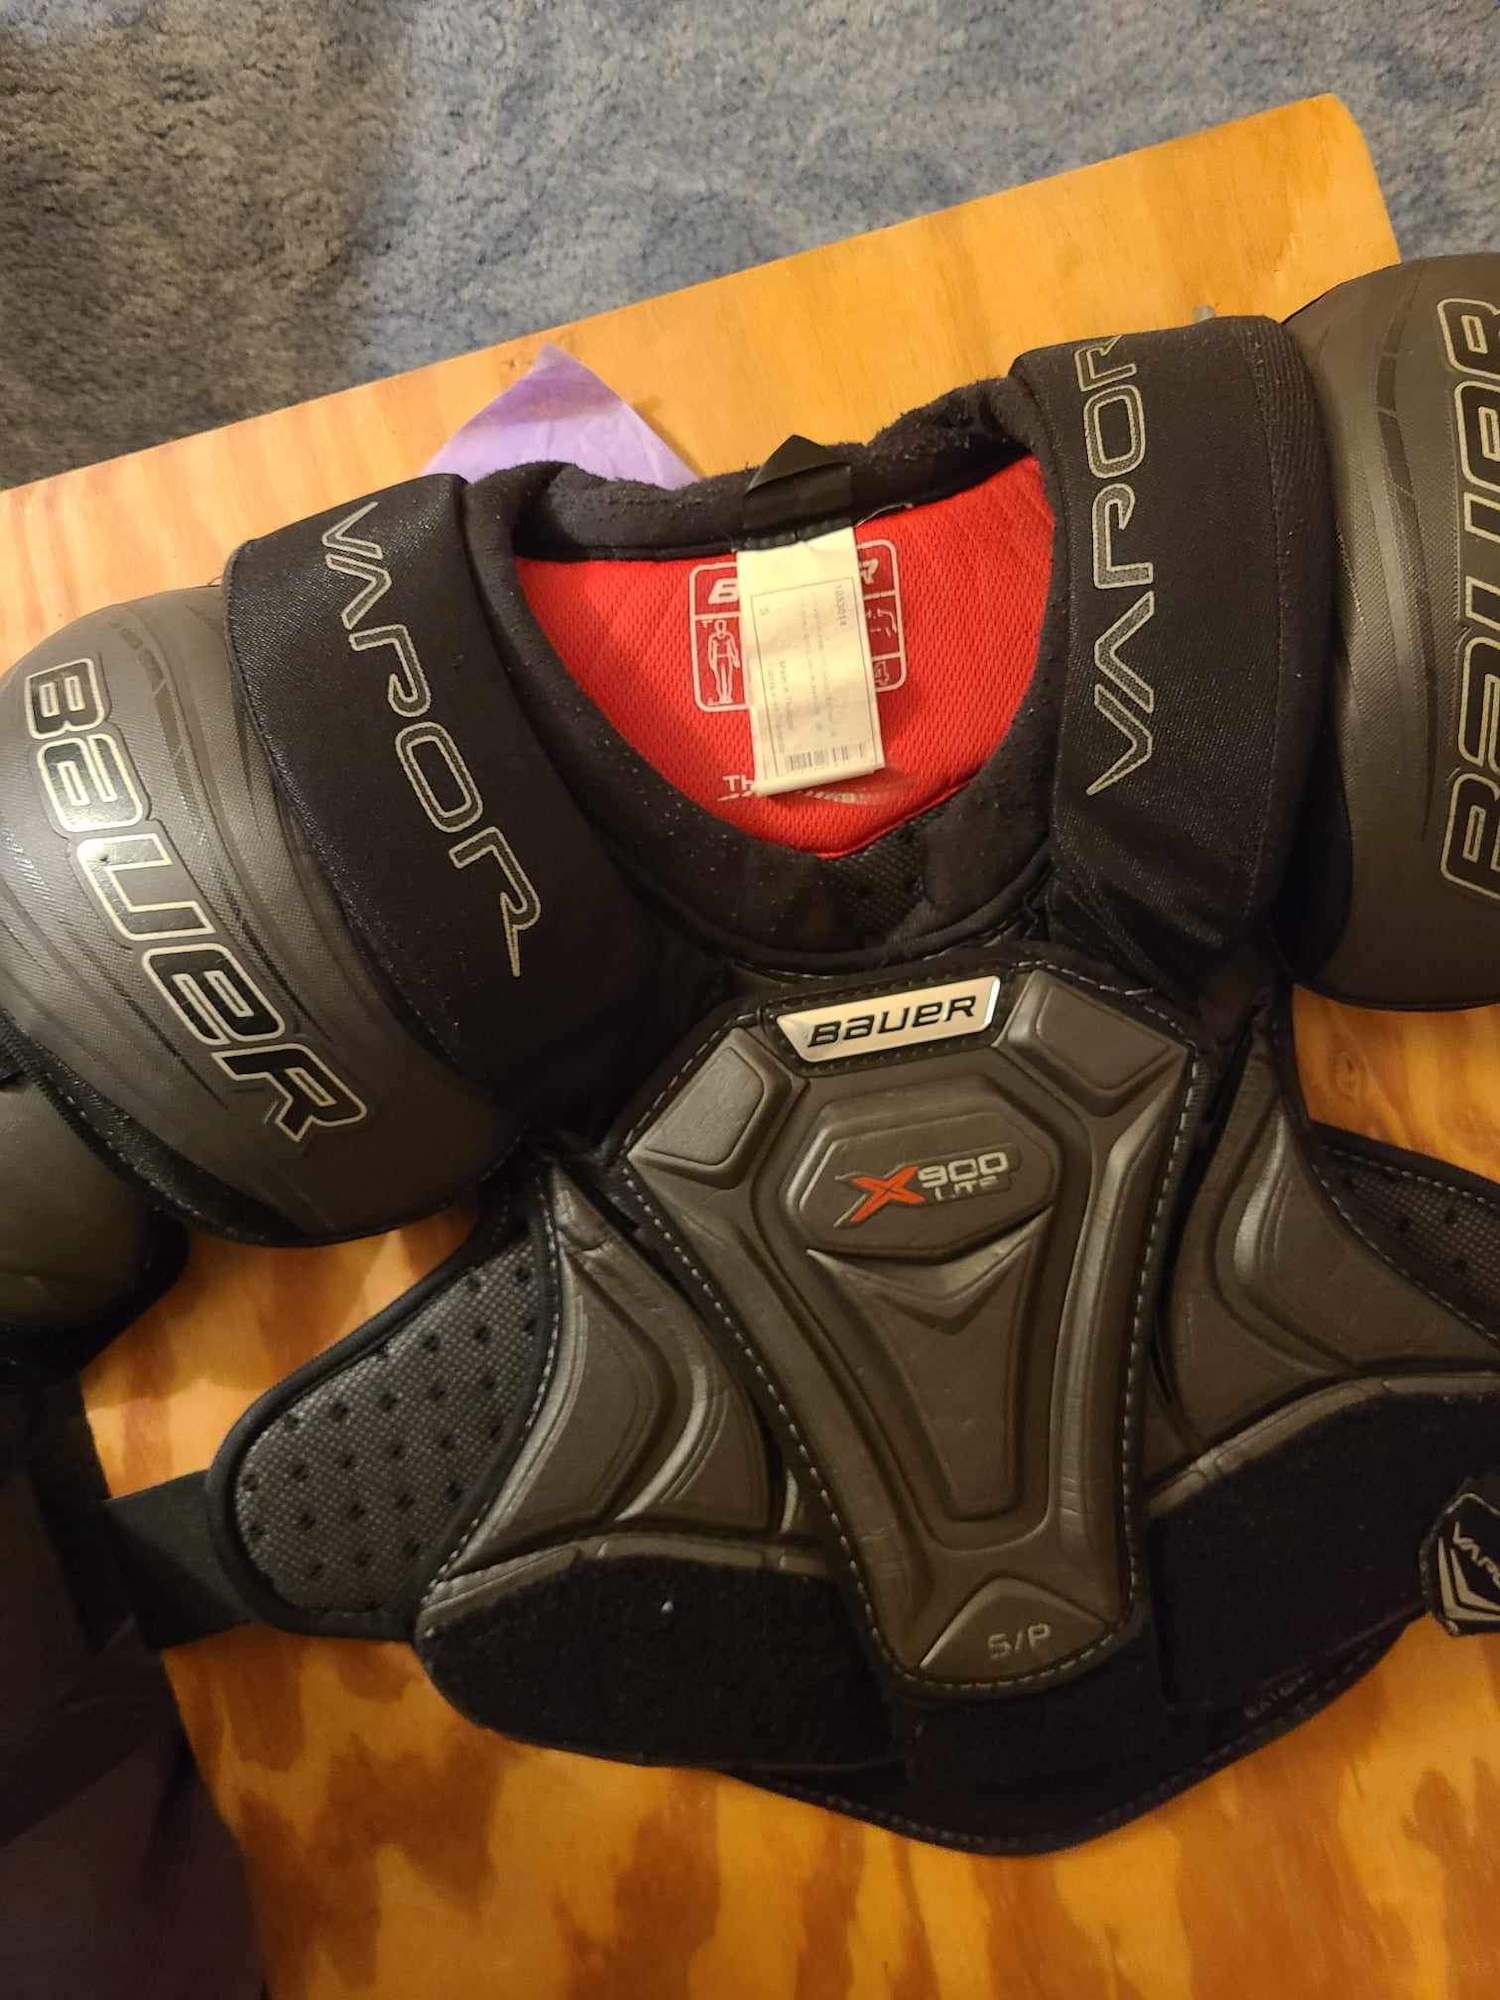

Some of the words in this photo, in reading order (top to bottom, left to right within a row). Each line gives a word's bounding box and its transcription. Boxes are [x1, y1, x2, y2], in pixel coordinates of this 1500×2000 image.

[322, 503, 540, 977] VAPOR
[1075, 334, 1153, 795] VAPOR
[25, 658, 366, 1141] BAUER
[807, 995, 976, 1048] BAUER
[988, 1623, 1050, 1660] S/P
